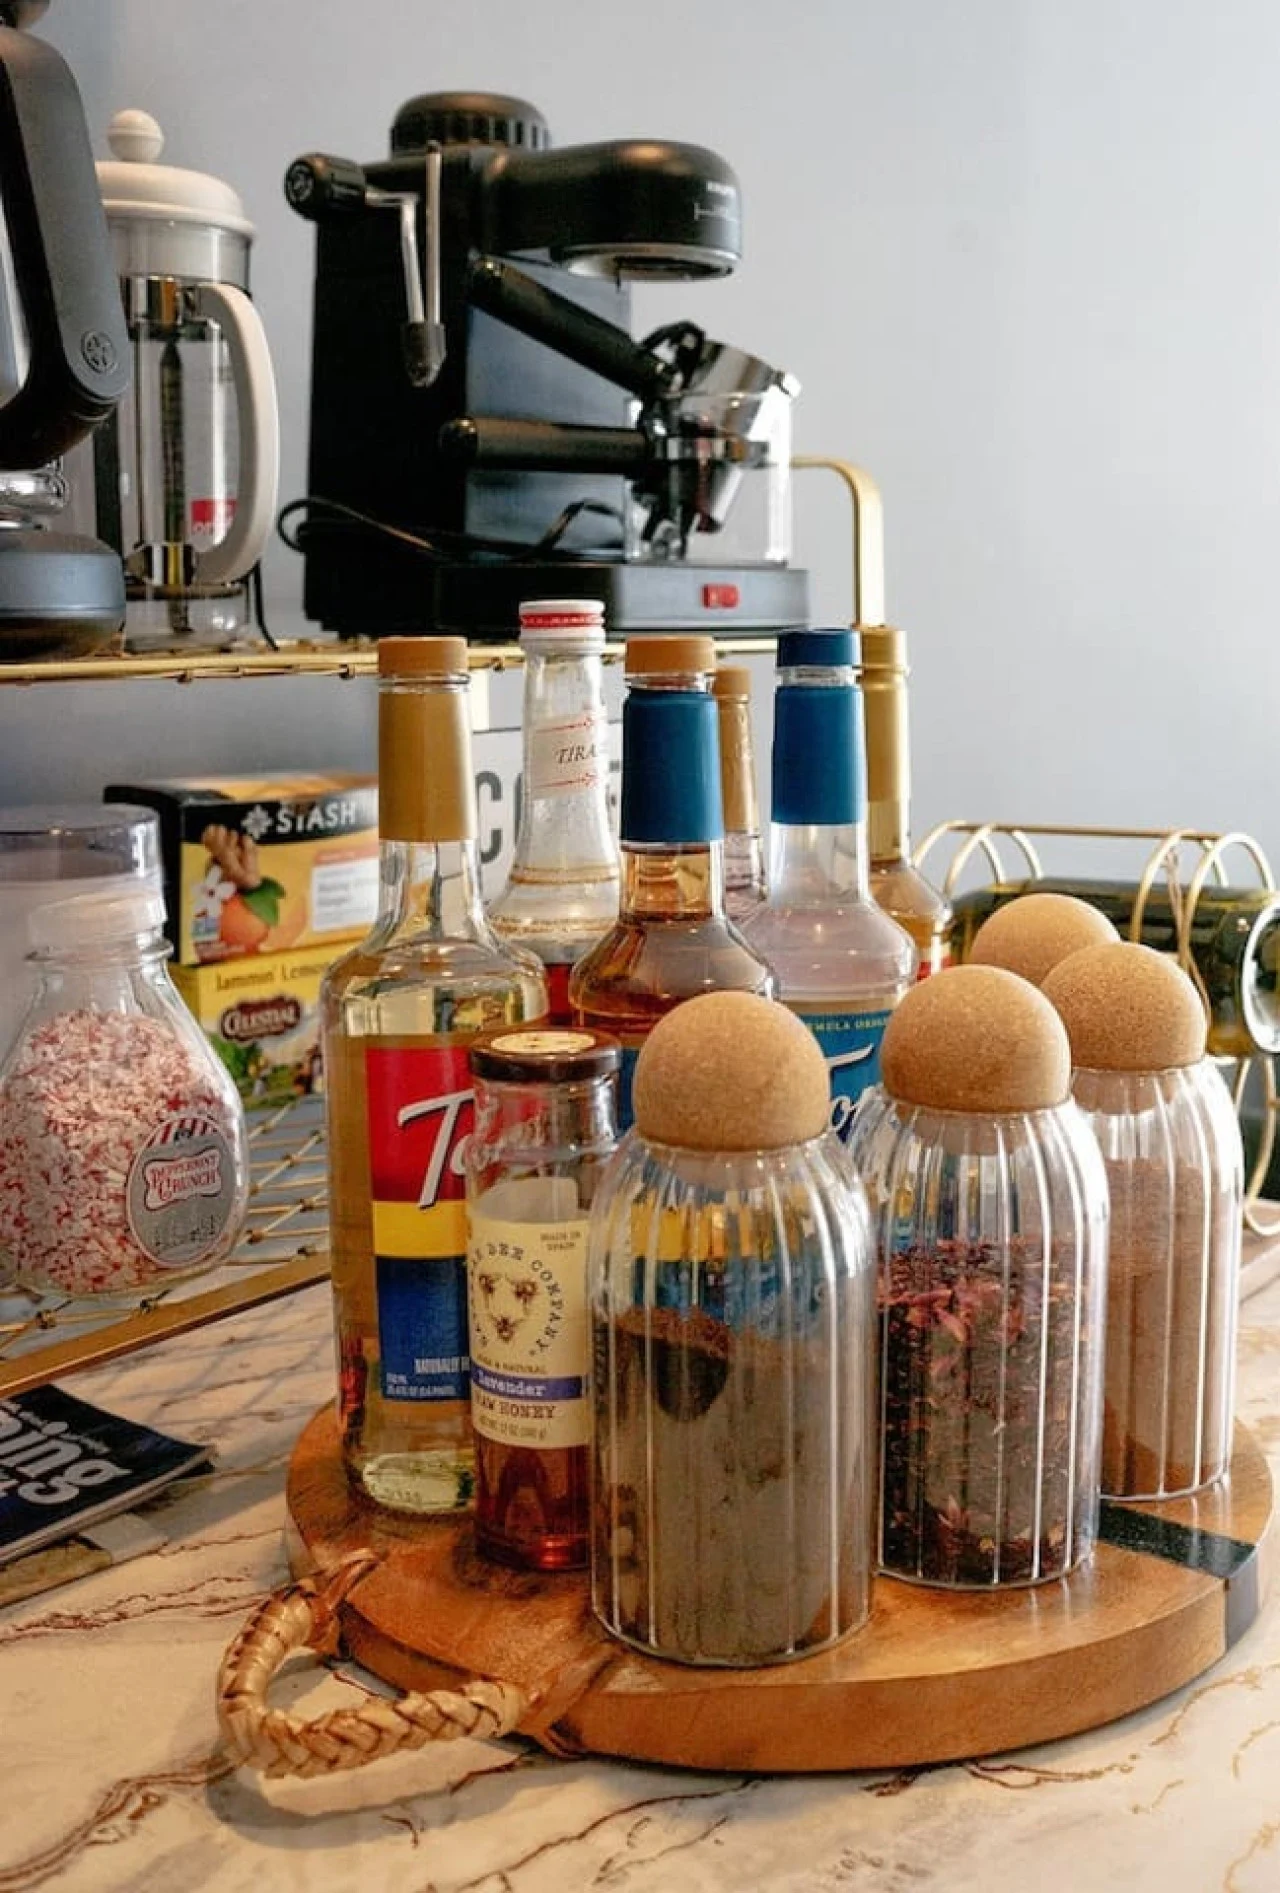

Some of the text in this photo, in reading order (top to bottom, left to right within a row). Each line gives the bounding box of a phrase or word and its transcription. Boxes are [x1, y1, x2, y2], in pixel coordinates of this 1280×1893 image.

[276, 800, 357, 833] STASH
[478, 1369, 546, 1396] Lavender
[500, 1402, 556, 1418] HONEY
